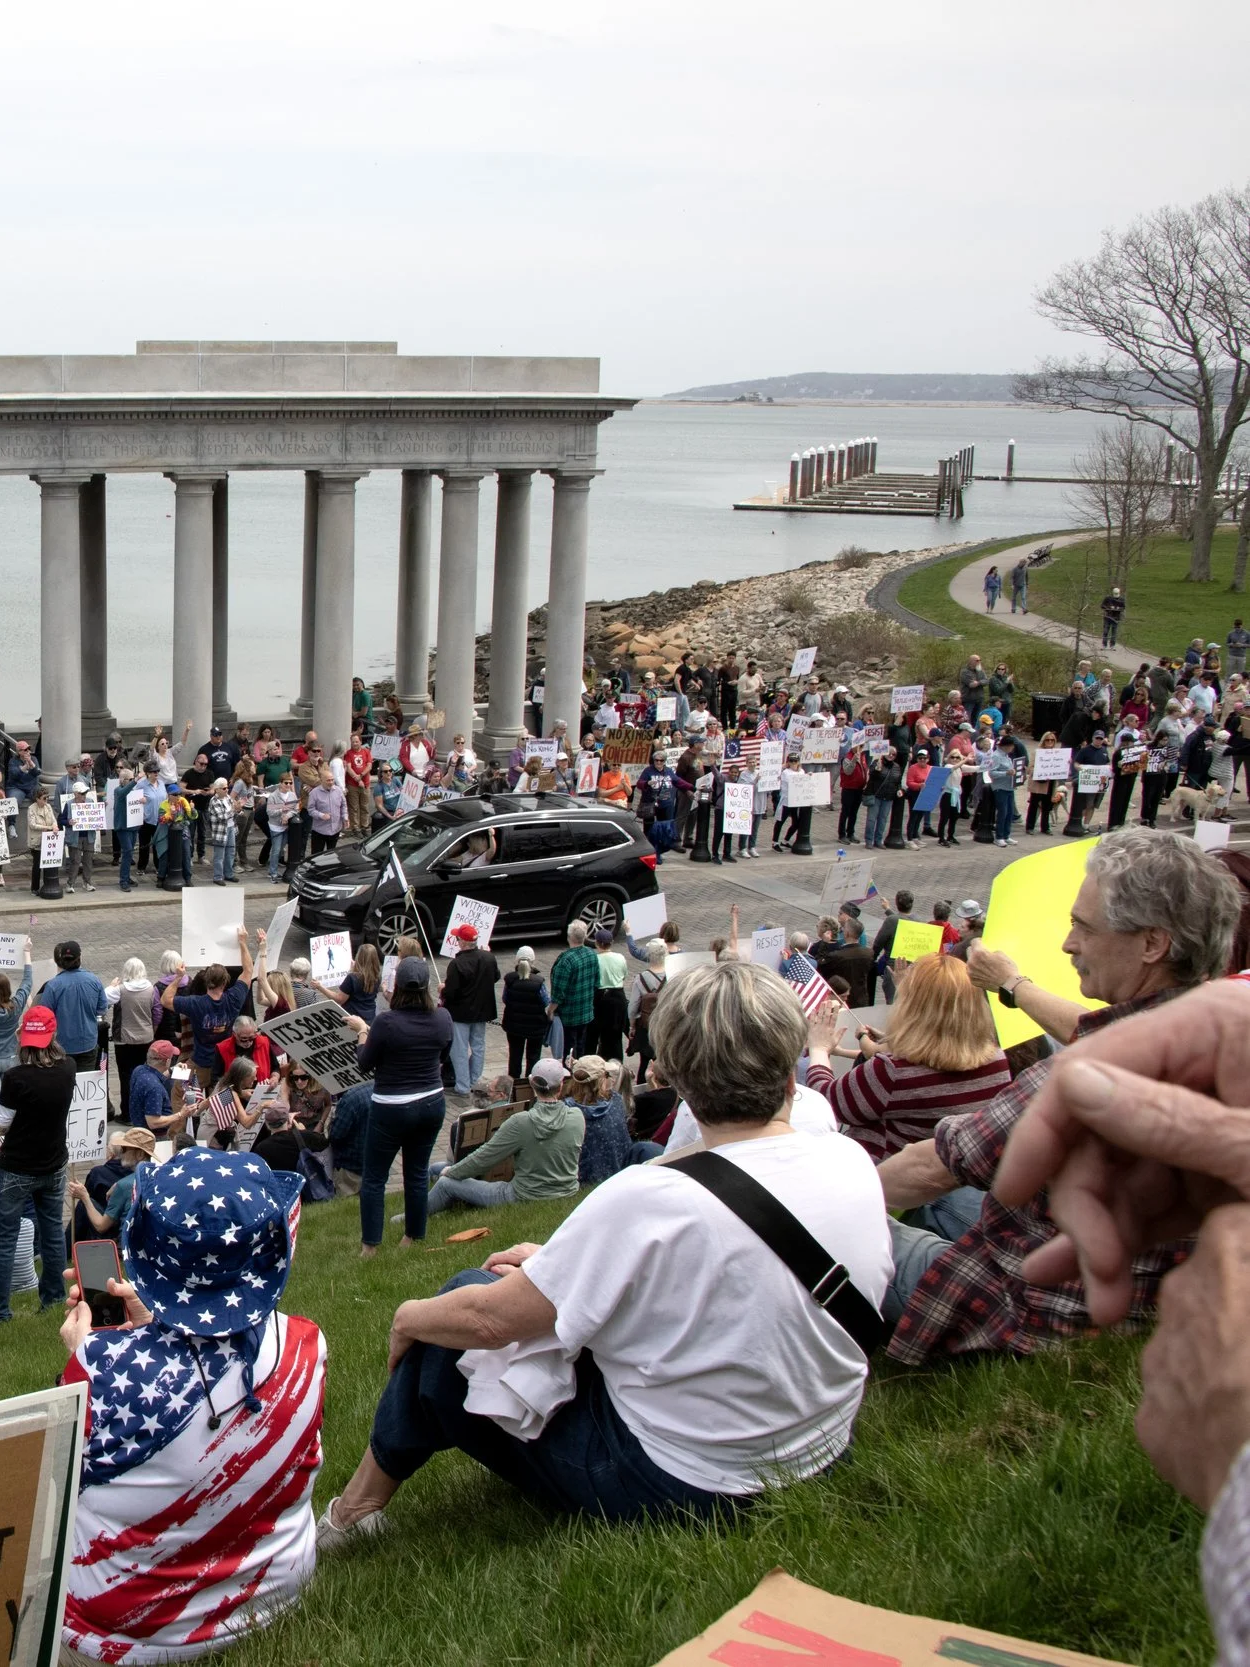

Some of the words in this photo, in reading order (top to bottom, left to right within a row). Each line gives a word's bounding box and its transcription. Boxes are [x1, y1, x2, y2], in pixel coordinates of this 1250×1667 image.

[101, 433, 177, 445] NATIONAL
[186, 432, 248, 444] SOCIETY
[281, 431, 307, 442] THE
[314, 431, 388, 442] COLONIAL
[395, 431, 440, 442] DAMES
[470, 431, 532, 442] AMERICA
[537, 431, 555, 442] TO
[81, 446, 105, 458] THE
[112, 445, 151, 457] THREE
[157, 444, 239, 456] HUNDREDTH
[244, 443, 332, 455] ANNIVERSARY
[359, 442, 384, 453] THE
[388, 442, 443, 453] LANDING
[468, 442, 492, 453] THE
[500, 441, 552, 453] PILGRIMS
[608, 730, 623, 740] NO
[623, 729, 652, 741] KINGS
[602, 744, 650, 764] CONTEMPT
[405, 780, 418, 799] NO
[727, 787, 738, 798] NO
[460, 898, 498, 916] WITHOUT
[468, 909, 482, 919] DUE
[454, 913, 490, 930] PROCESS
[756, 934, 783, 951] RESIST
[270, 1022, 304, 1046] IT'S
[294, 1012, 322, 1036] SO
[319, 1008, 348, 1031] BAD
[304, 1034, 330, 1051] EVEN
[323, 1031, 344, 1044] THE
[333, 1070, 362, 1088] ARE
